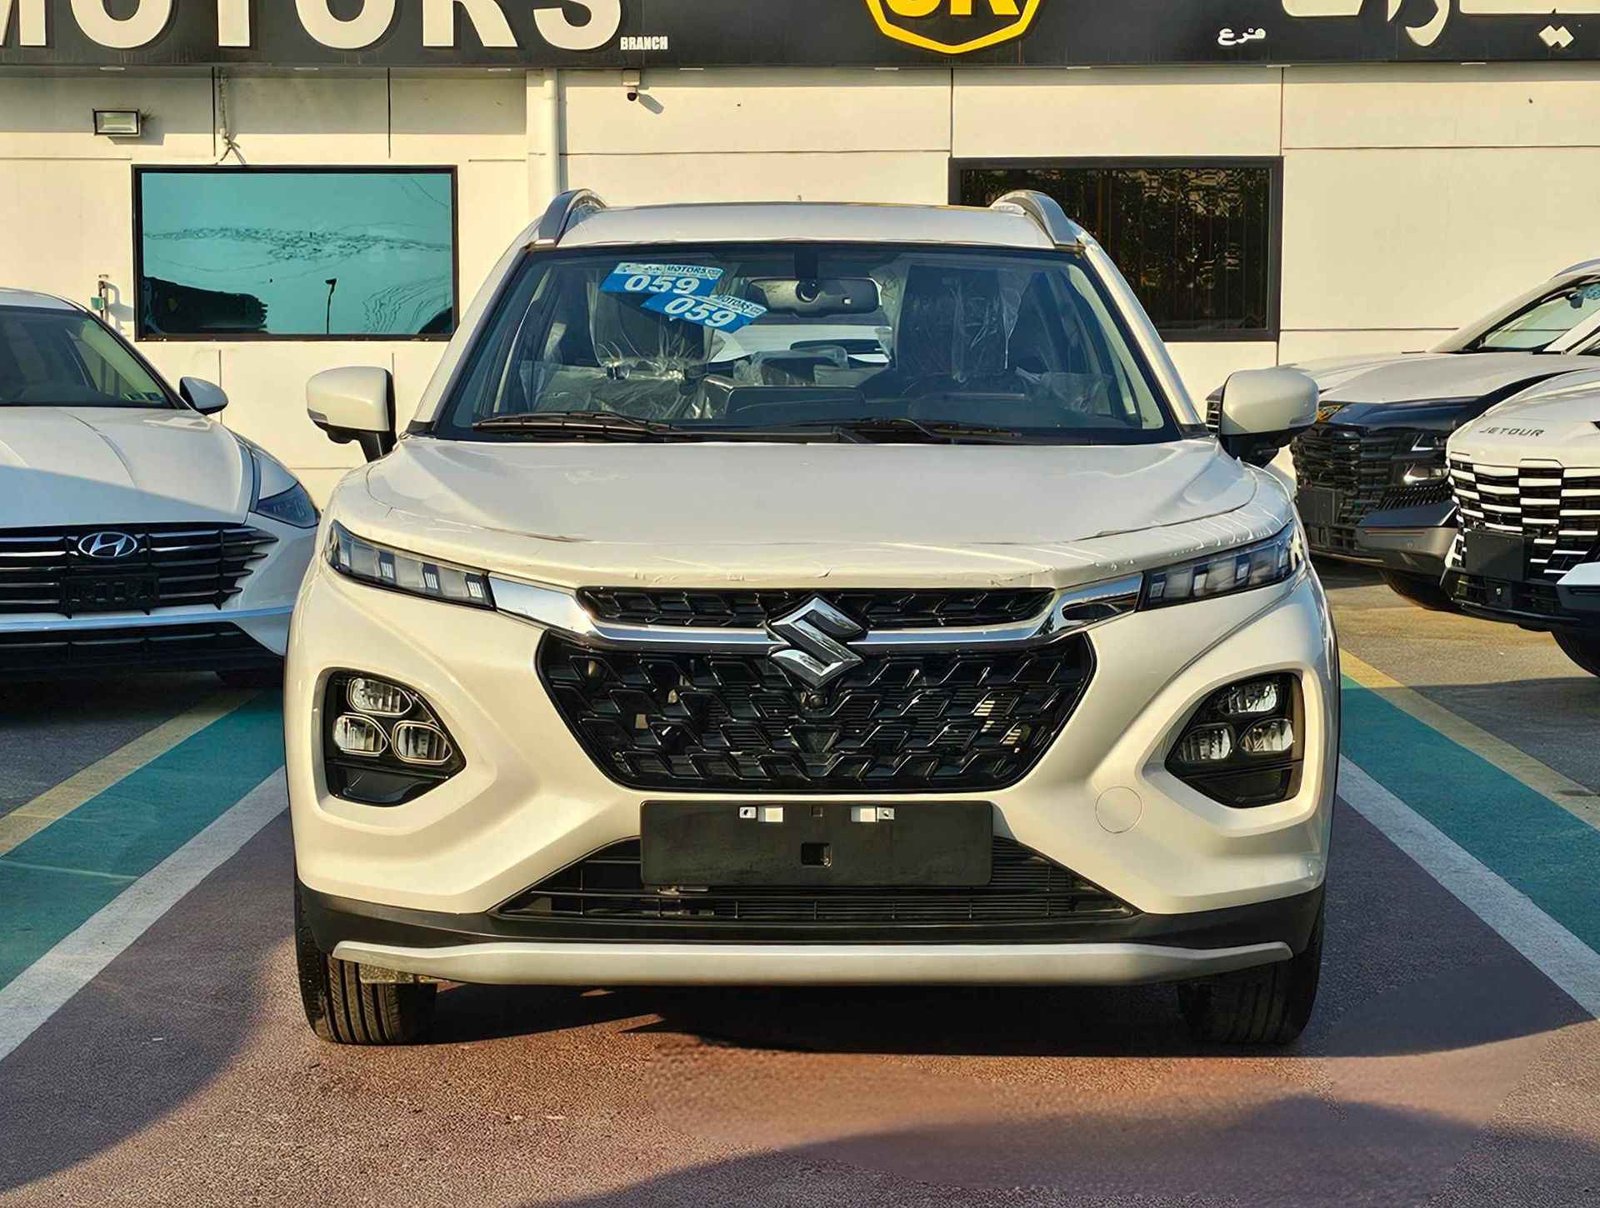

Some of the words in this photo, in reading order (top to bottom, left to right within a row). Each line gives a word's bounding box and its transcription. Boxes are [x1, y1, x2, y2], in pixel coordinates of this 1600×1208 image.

[620, 36, 668, 50] BRANCH
[1217, 27, 1267, 46] فرع
[623, 275, 700, 295] 059
[664, 297, 738, 328] 059
[1479, 426, 1545, 437] JETOUR
